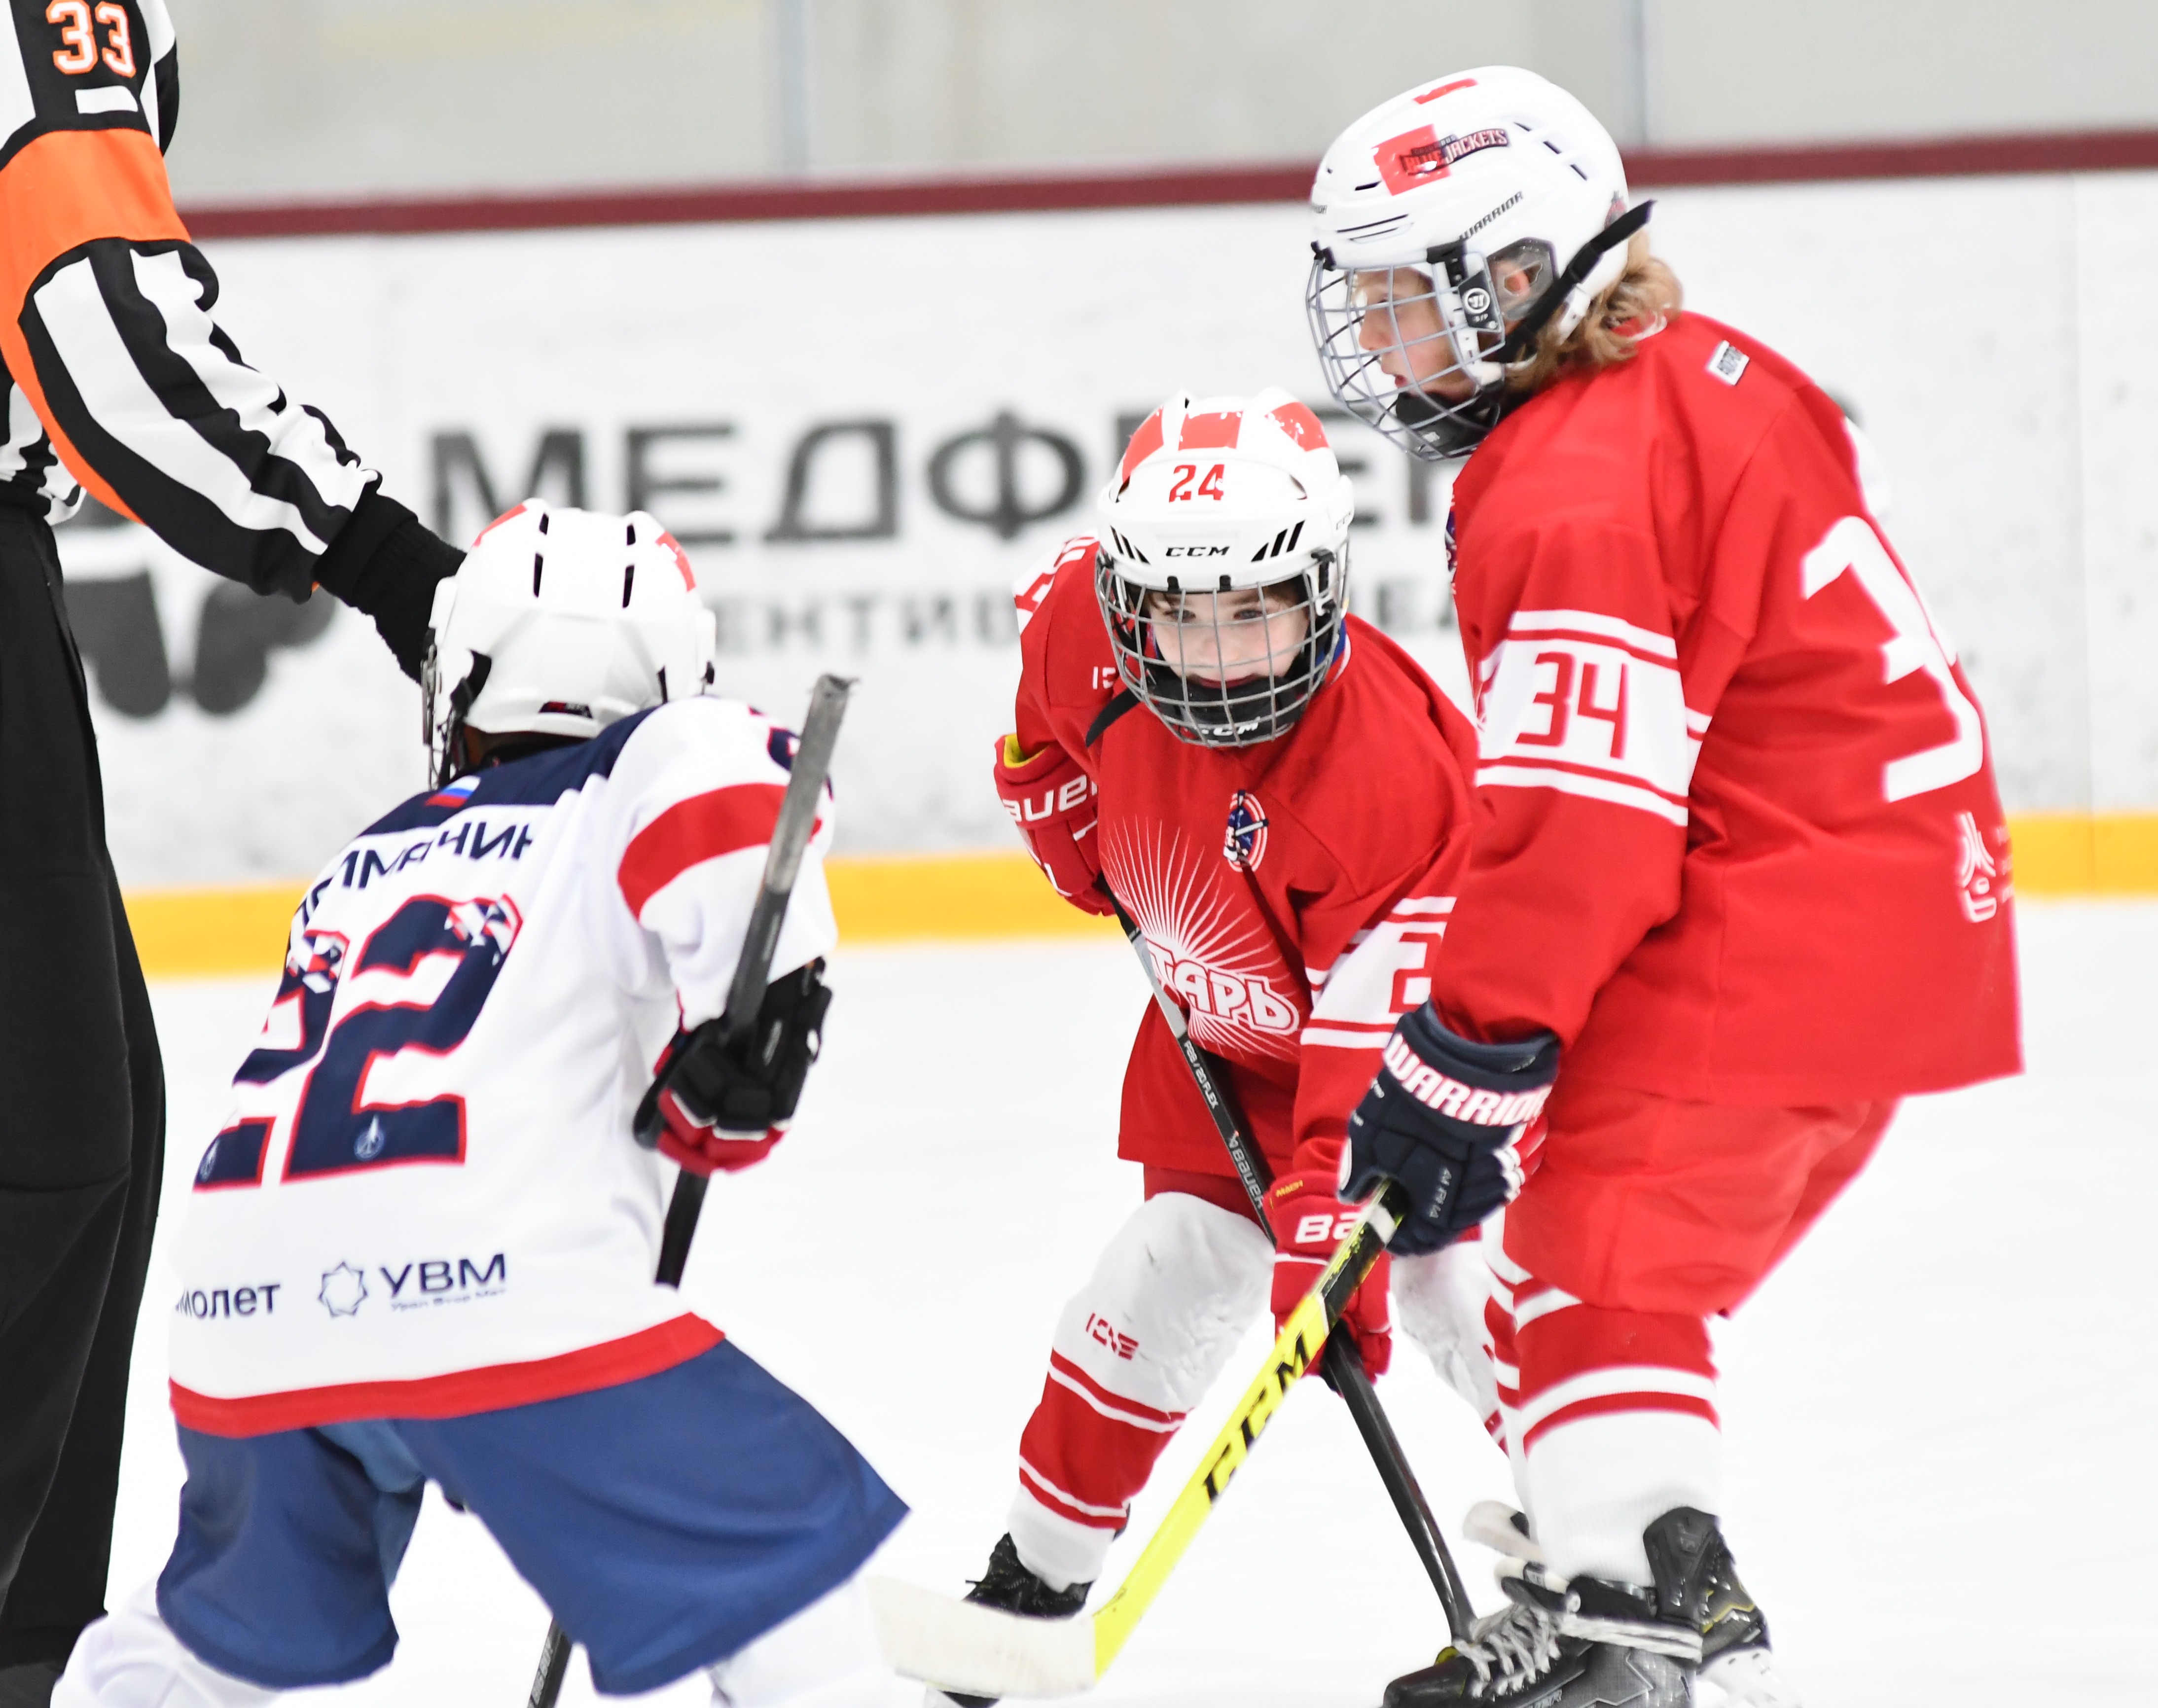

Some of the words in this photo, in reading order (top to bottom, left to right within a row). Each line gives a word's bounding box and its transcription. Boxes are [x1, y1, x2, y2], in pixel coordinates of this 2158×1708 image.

[46, 0, 136, 77] 33
[1443, 128, 1508, 164] JACKETS
[1458, 190, 1523, 241] WARRIOR
[1169, 464, 1225, 502] 24
[1165, 545, 1230, 557] CCM
[1202, 716, 1260, 736] CM
[1515, 651, 1629, 760] 34
[193, 893, 524, 1194] 22
[1202, 1080, 1220, 1110] FLEX
[379, 1253, 506, 1299] УВМ
[176, 1284, 280, 1319] молет
[1202, 1328, 1310, 1504] CCM
